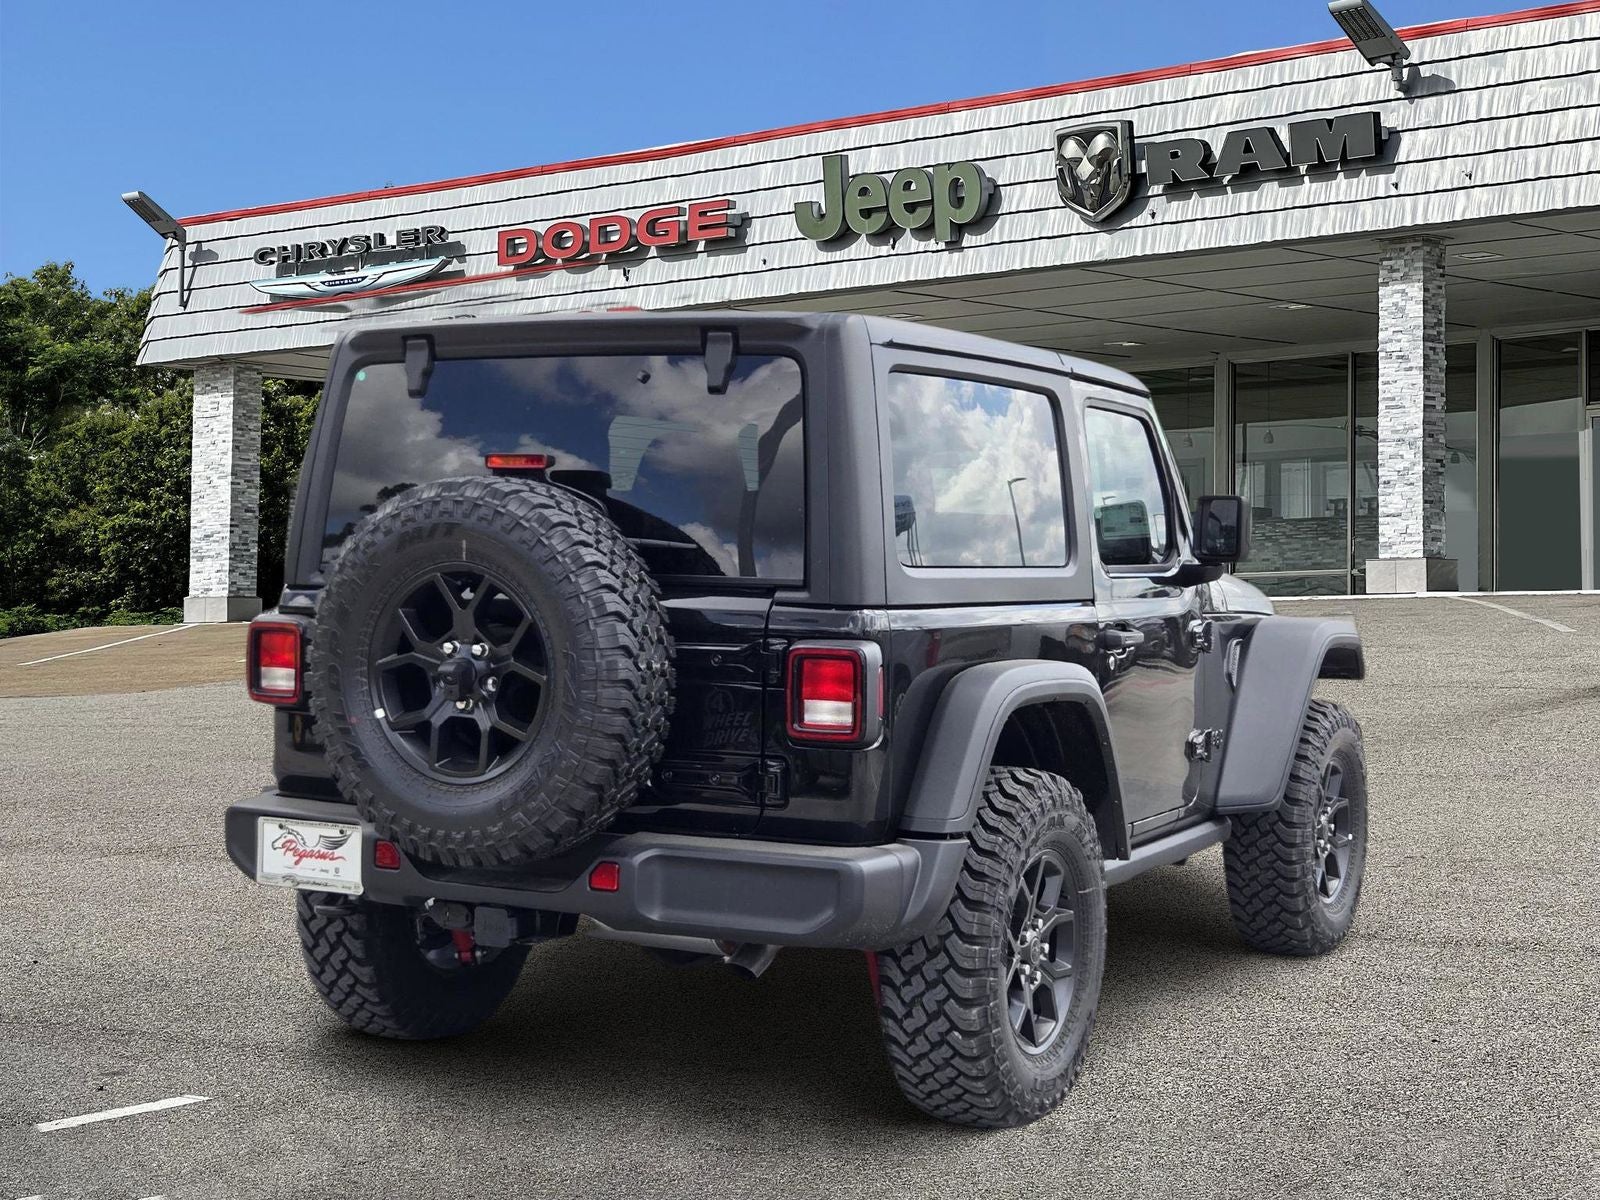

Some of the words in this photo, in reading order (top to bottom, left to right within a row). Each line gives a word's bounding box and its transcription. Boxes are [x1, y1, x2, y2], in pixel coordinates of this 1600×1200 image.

[1144, 112, 1380, 187] RAM
[794, 154, 990, 243] Jeep
[253, 225, 449, 267] CHRYSLER
[497, 199, 736, 266] DODGE
[324, 277, 362, 286] CHRYSLER
[281, 838, 347, 866] Pegasus
